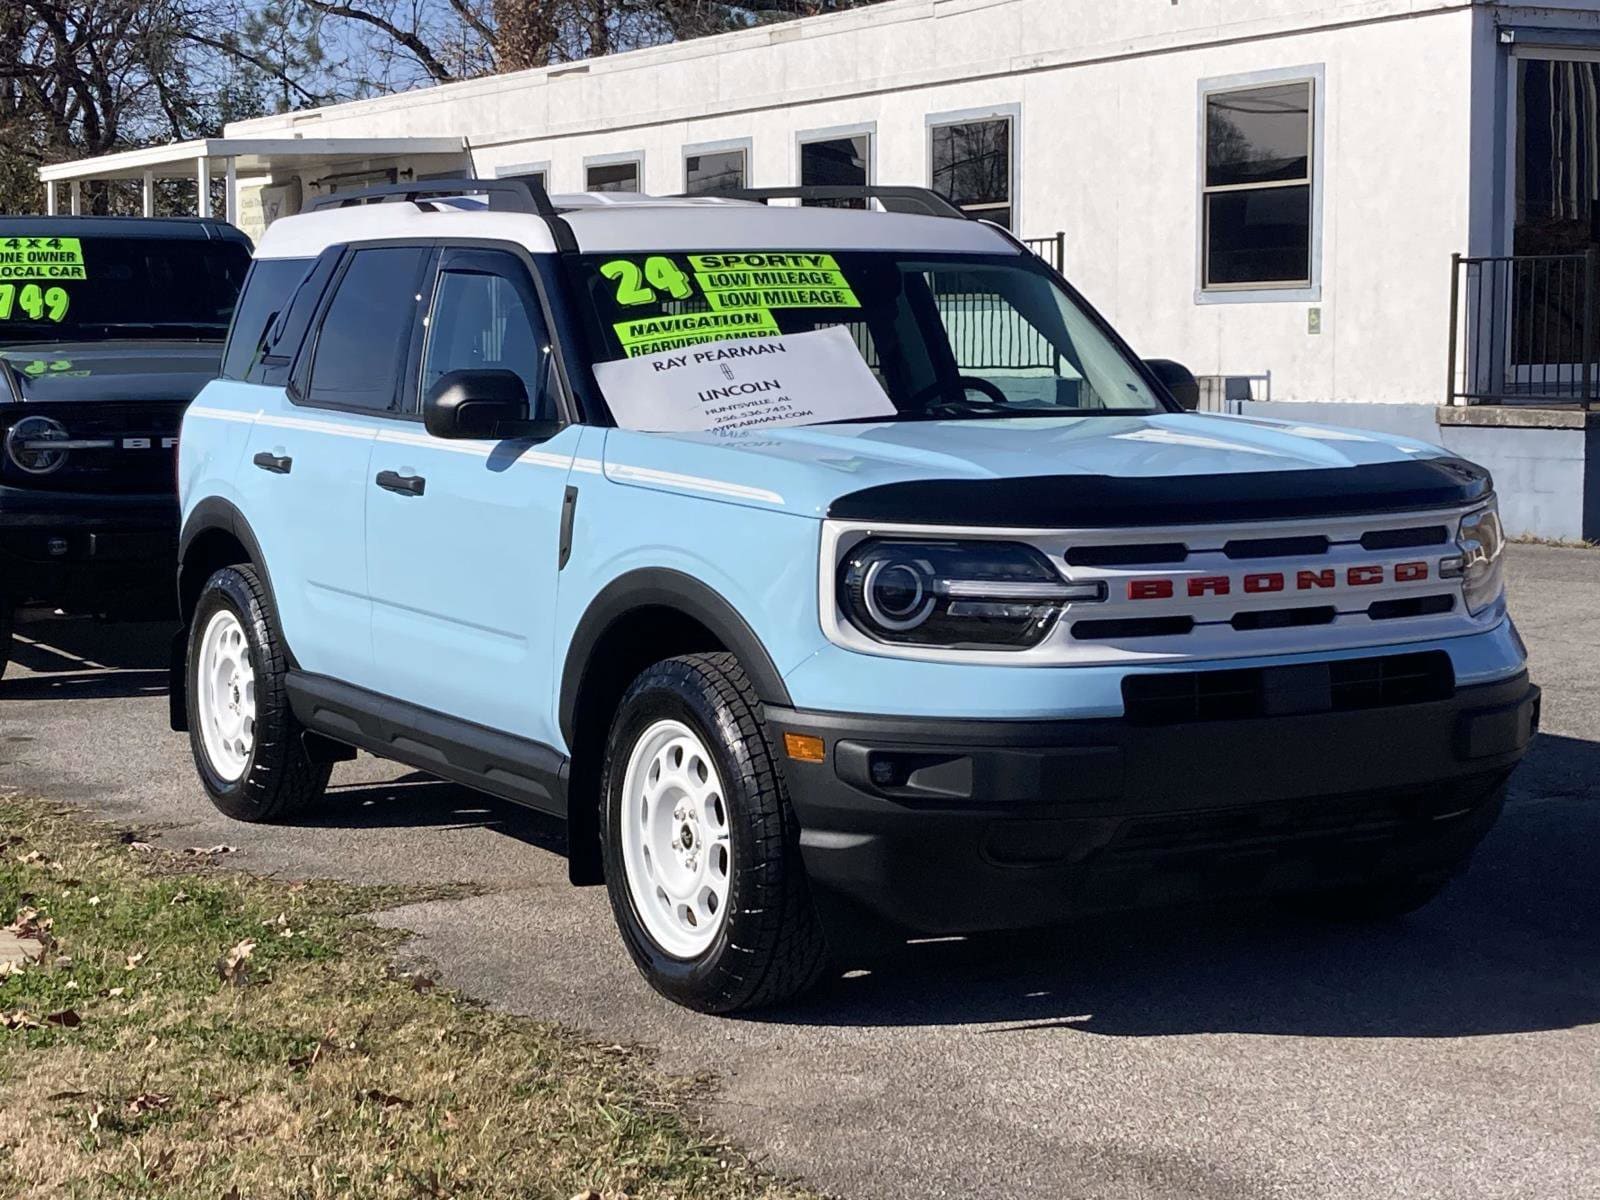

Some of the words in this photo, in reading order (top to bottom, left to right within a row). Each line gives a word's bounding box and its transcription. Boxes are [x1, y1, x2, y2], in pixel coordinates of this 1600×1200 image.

[27, 251, 75, 262] OWNER
[700, 254, 824, 269] SPORTY
[0, 266, 47, 277] OCAL
[48, 266, 82, 277] CAR
[600, 256, 693, 306] 24
[707, 272, 750, 288] LOW
[752, 272, 836, 286] MILEAGE
[718, 292, 761, 308] LOW
[763, 290, 848, 305] MILEAGE
[629, 312, 763, 338] NAVIGATION
[629, 335, 709, 358] REARVIEW
[652, 355, 688, 373] RAY
[693, 342, 787, 364] PEARMAN
[697, 379, 782, 402] LINCOLN
[1127, 561, 1428, 600] BRONCO
